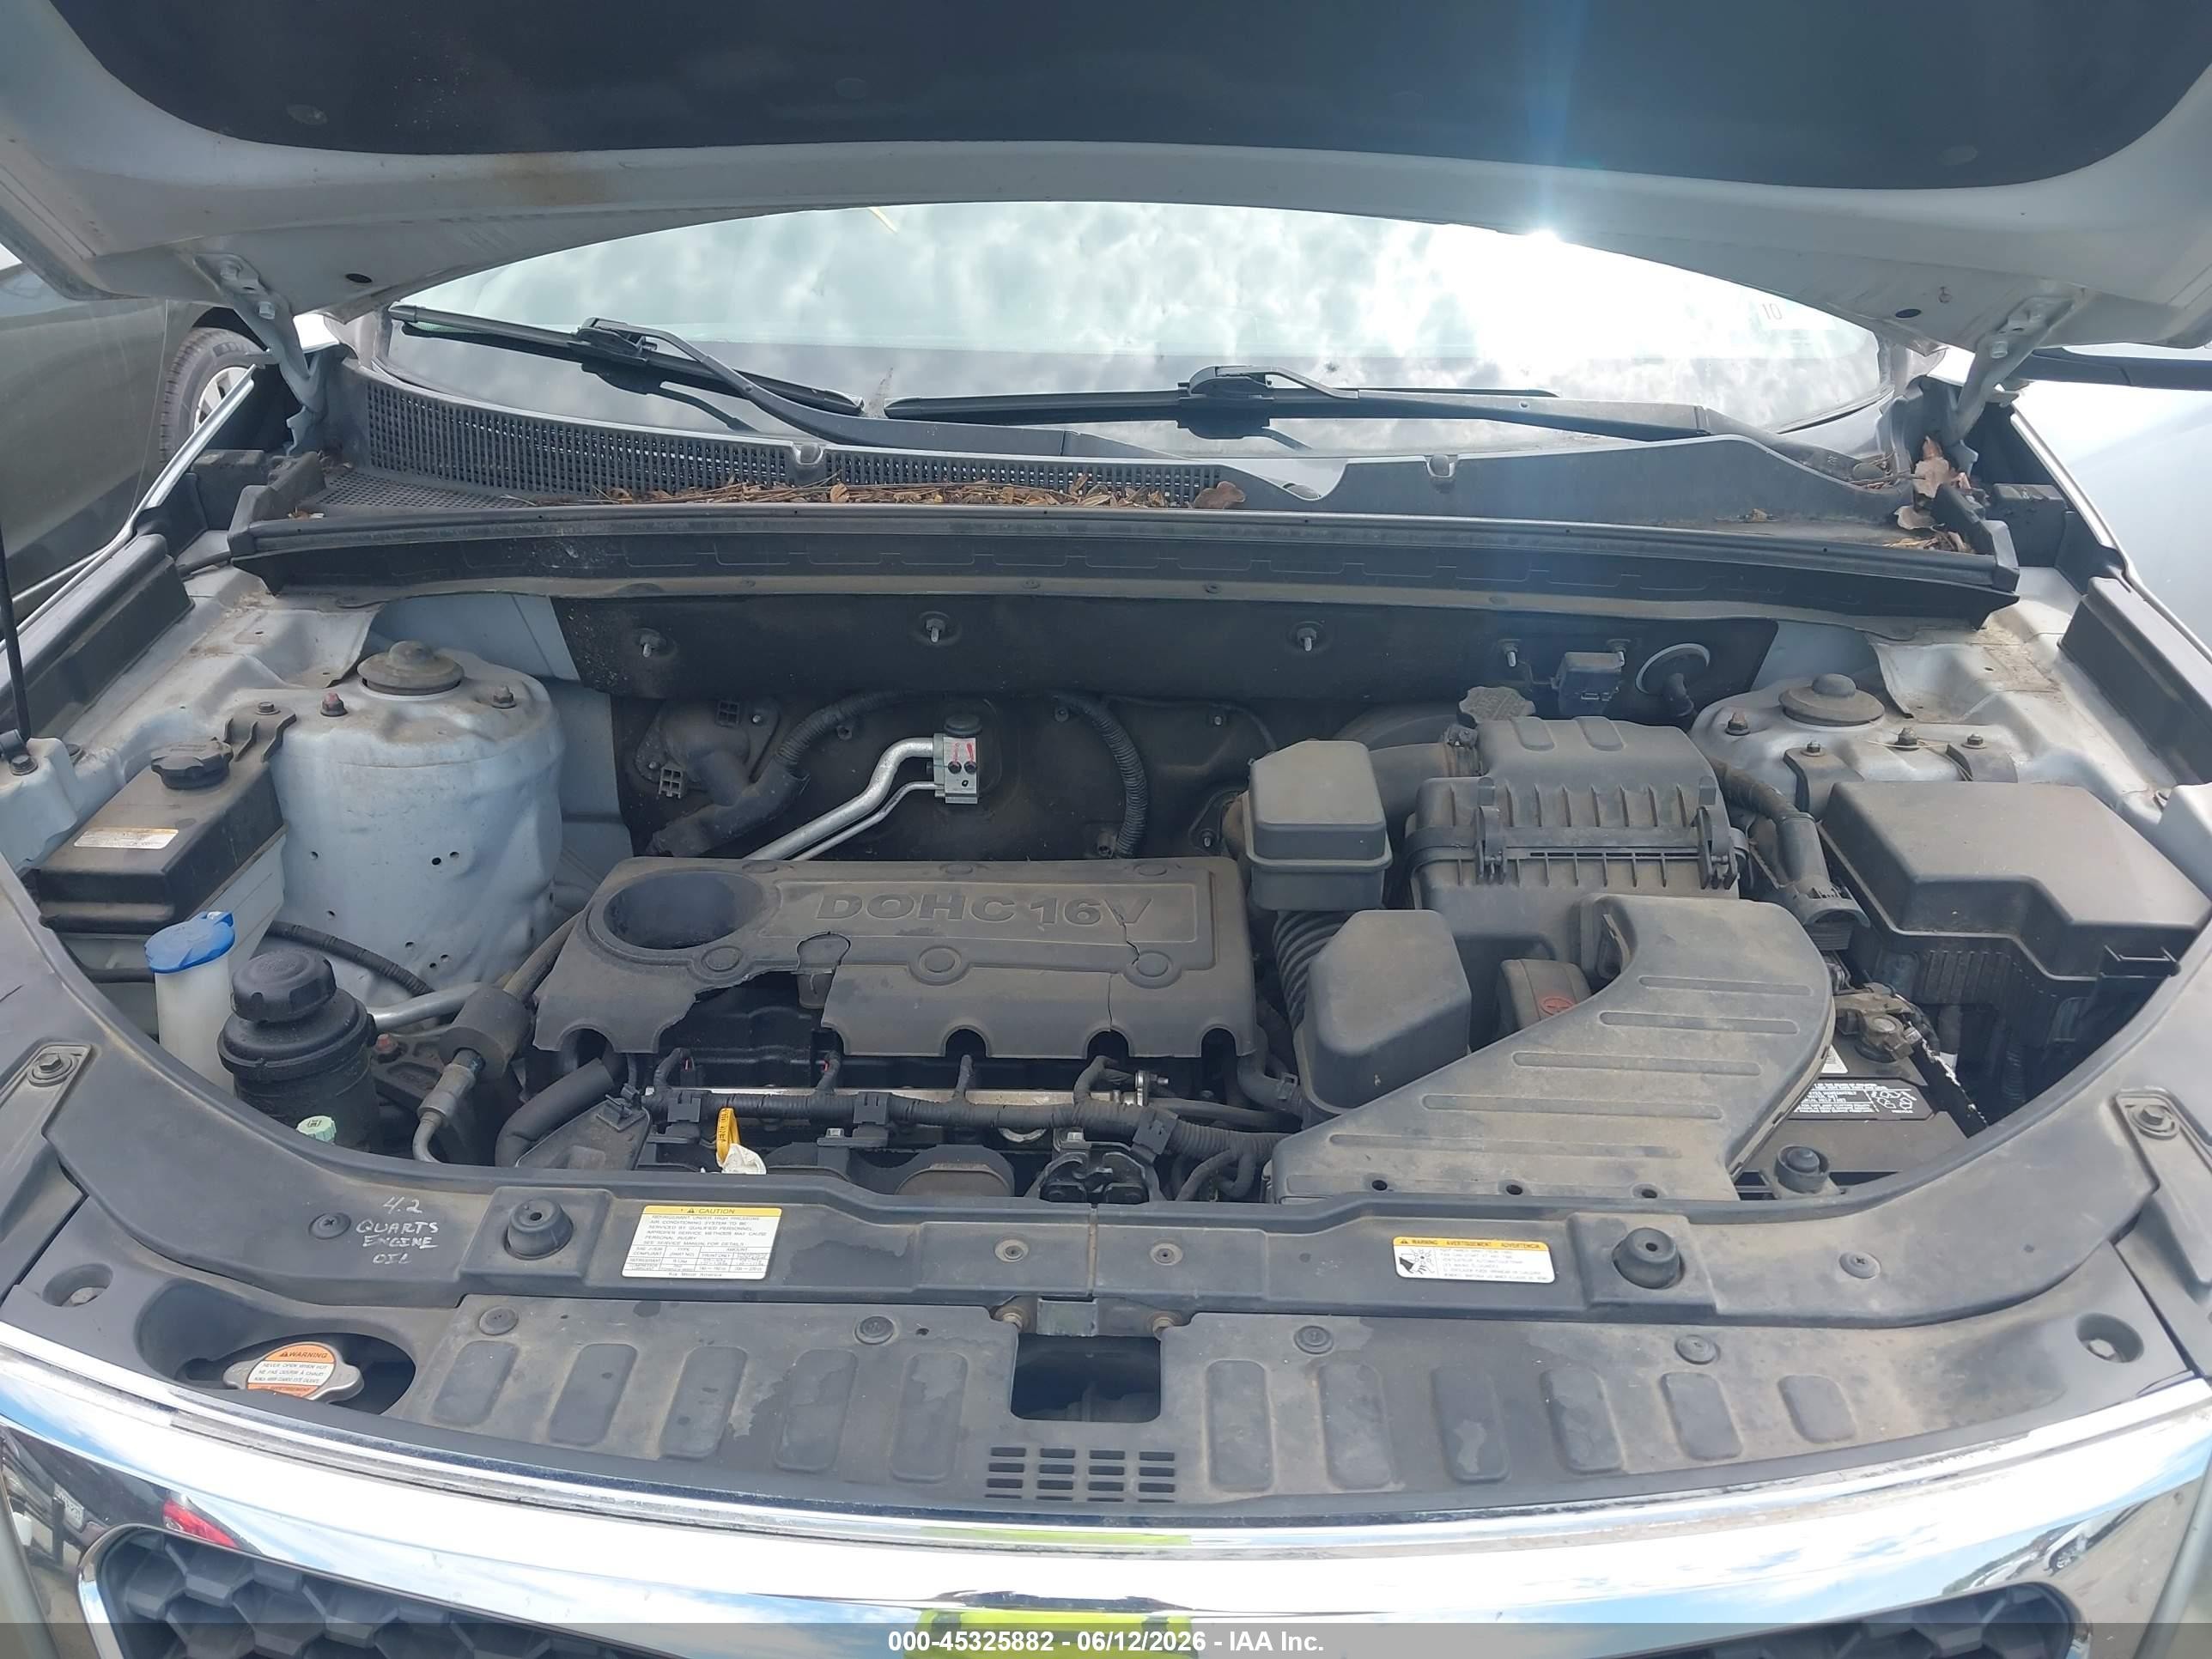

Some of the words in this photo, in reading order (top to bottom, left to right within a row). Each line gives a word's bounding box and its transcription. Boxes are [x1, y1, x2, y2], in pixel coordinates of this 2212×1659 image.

[815, 893, 1017, 922] DOHC
[1030, 896, 1152, 926] 16V
[382, 1196, 422, 1214] 4.2
[356, 1219, 440, 1235] QUARTS
[373, 1253, 412, 1265] OIL
